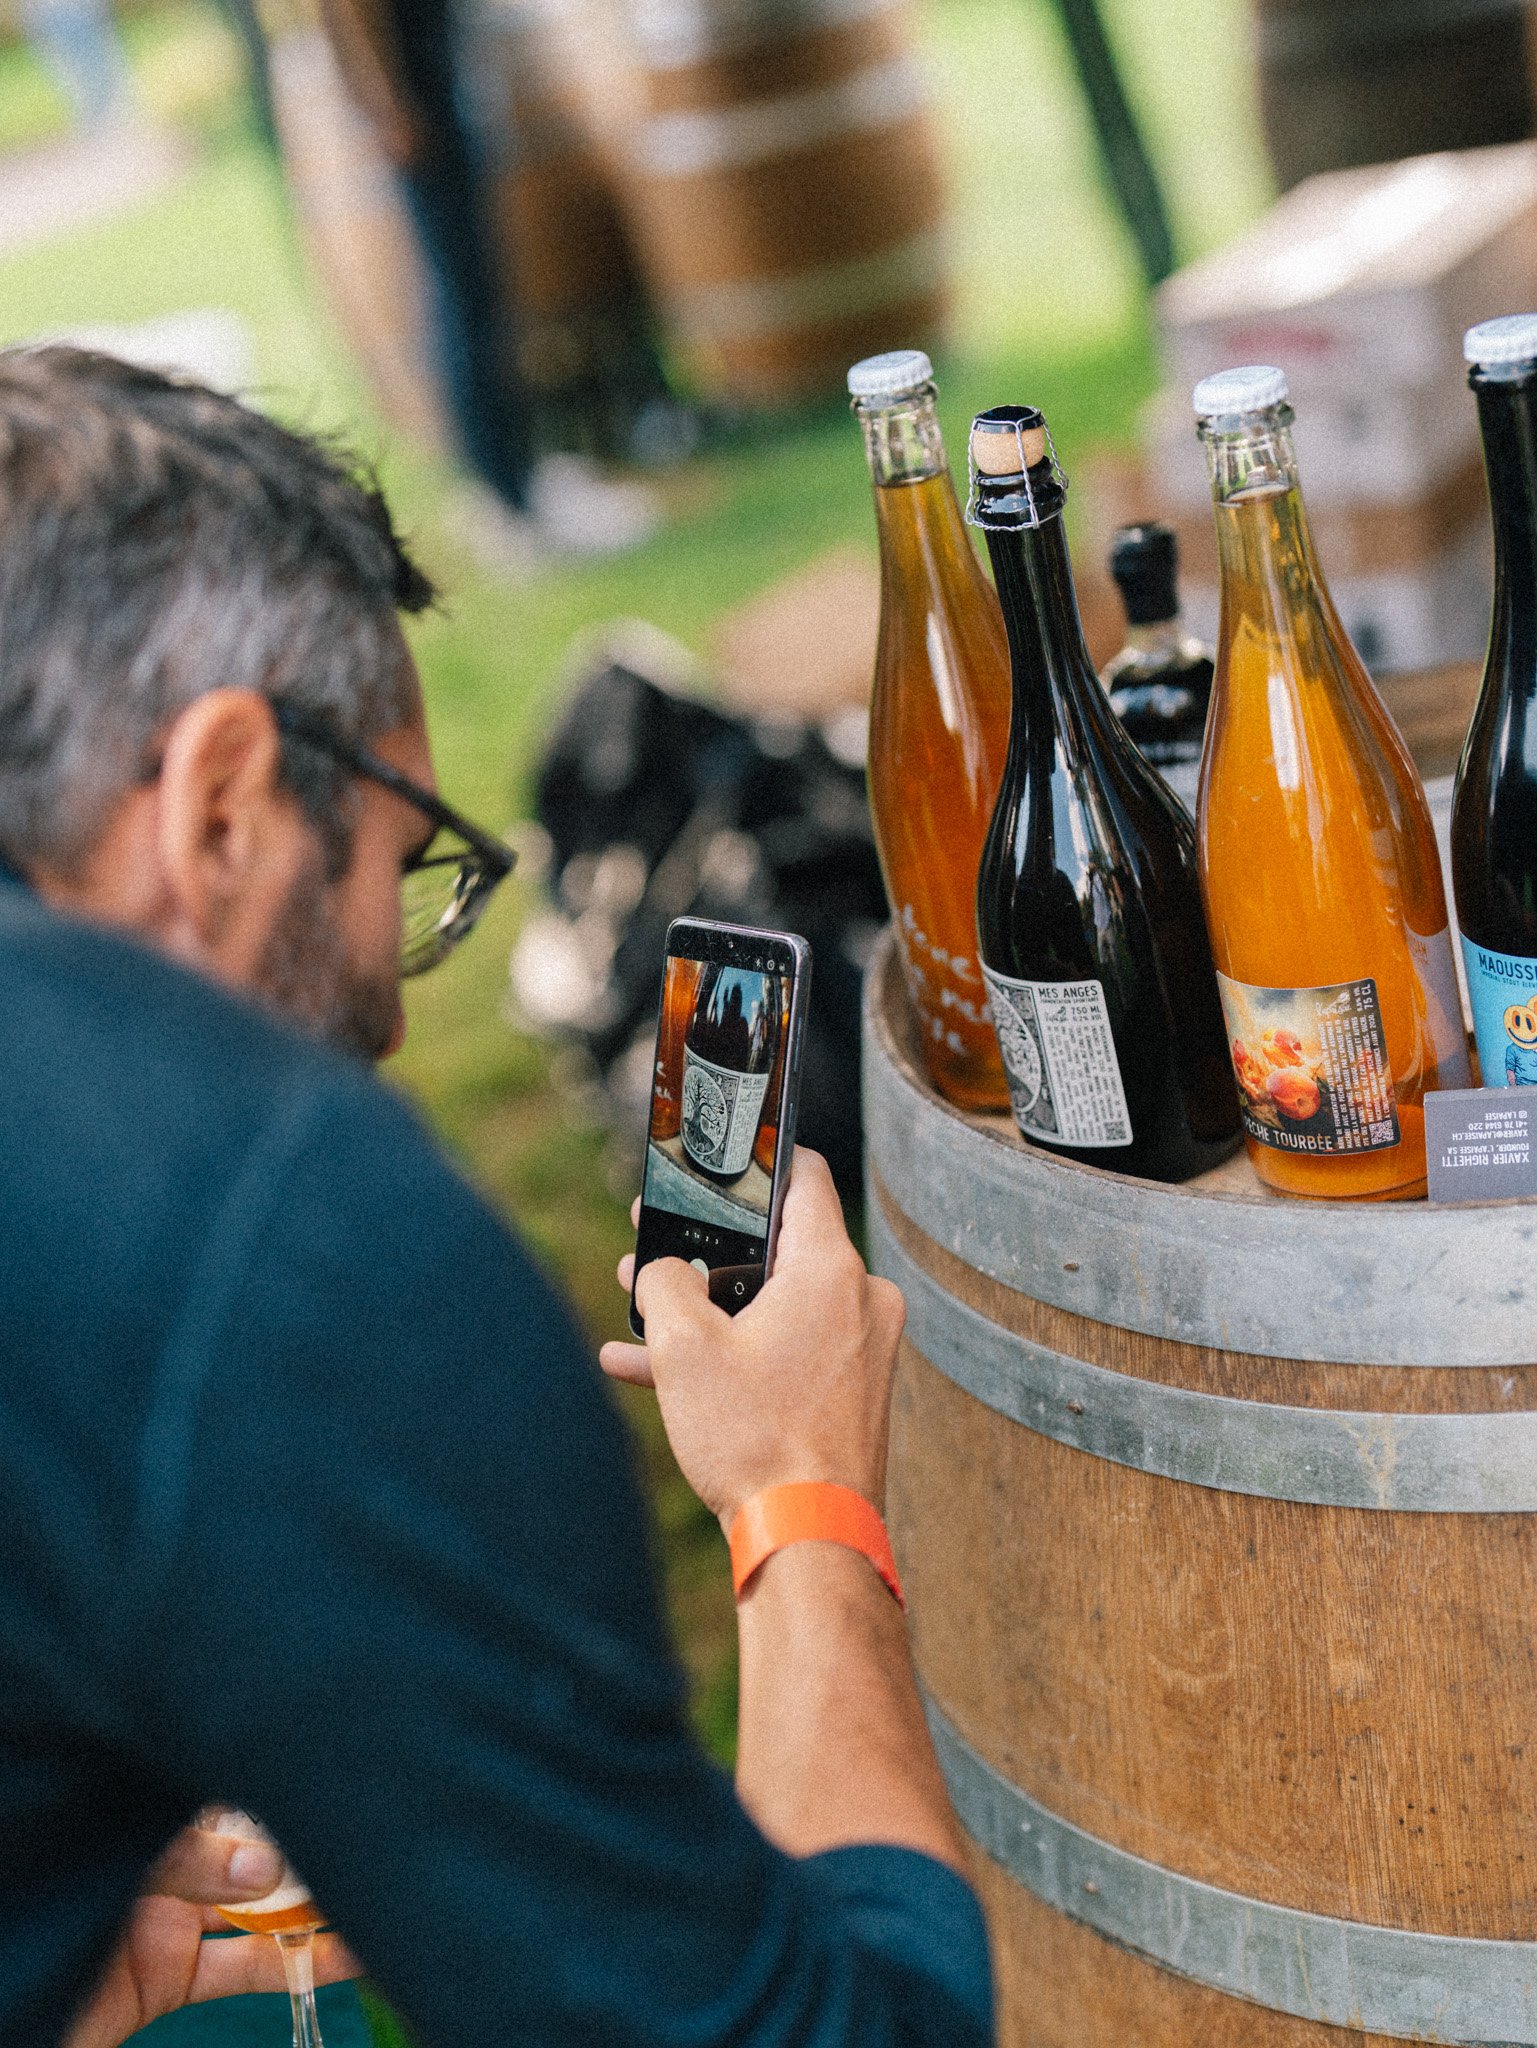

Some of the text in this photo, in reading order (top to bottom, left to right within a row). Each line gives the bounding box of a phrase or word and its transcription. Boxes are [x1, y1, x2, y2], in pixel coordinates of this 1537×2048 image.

[1478, 952, 1537, 981] MAOUSS
[1038, 986, 1098, 999] MES ANGES
[1361, 984, 1373, 1009] 75 CL
[1071, 1005, 1101, 1015] 750 ML
[1351, 1017, 1360, 1036] AUTRES
[1330, 1094, 1340, 1127] FERMENTATION
[1484, 1111, 1517, 1121] LAPAISEE
[1468, 1120, 1528, 1131] +41 78 6144 220
[1273, 1130, 1333, 1150] TOURBÉE
[1452, 1129, 1528, 1141] XAVIER@LAPAISEE.CH
[1442, 1152, 1530, 1167] XAVIER RIGHETTI
